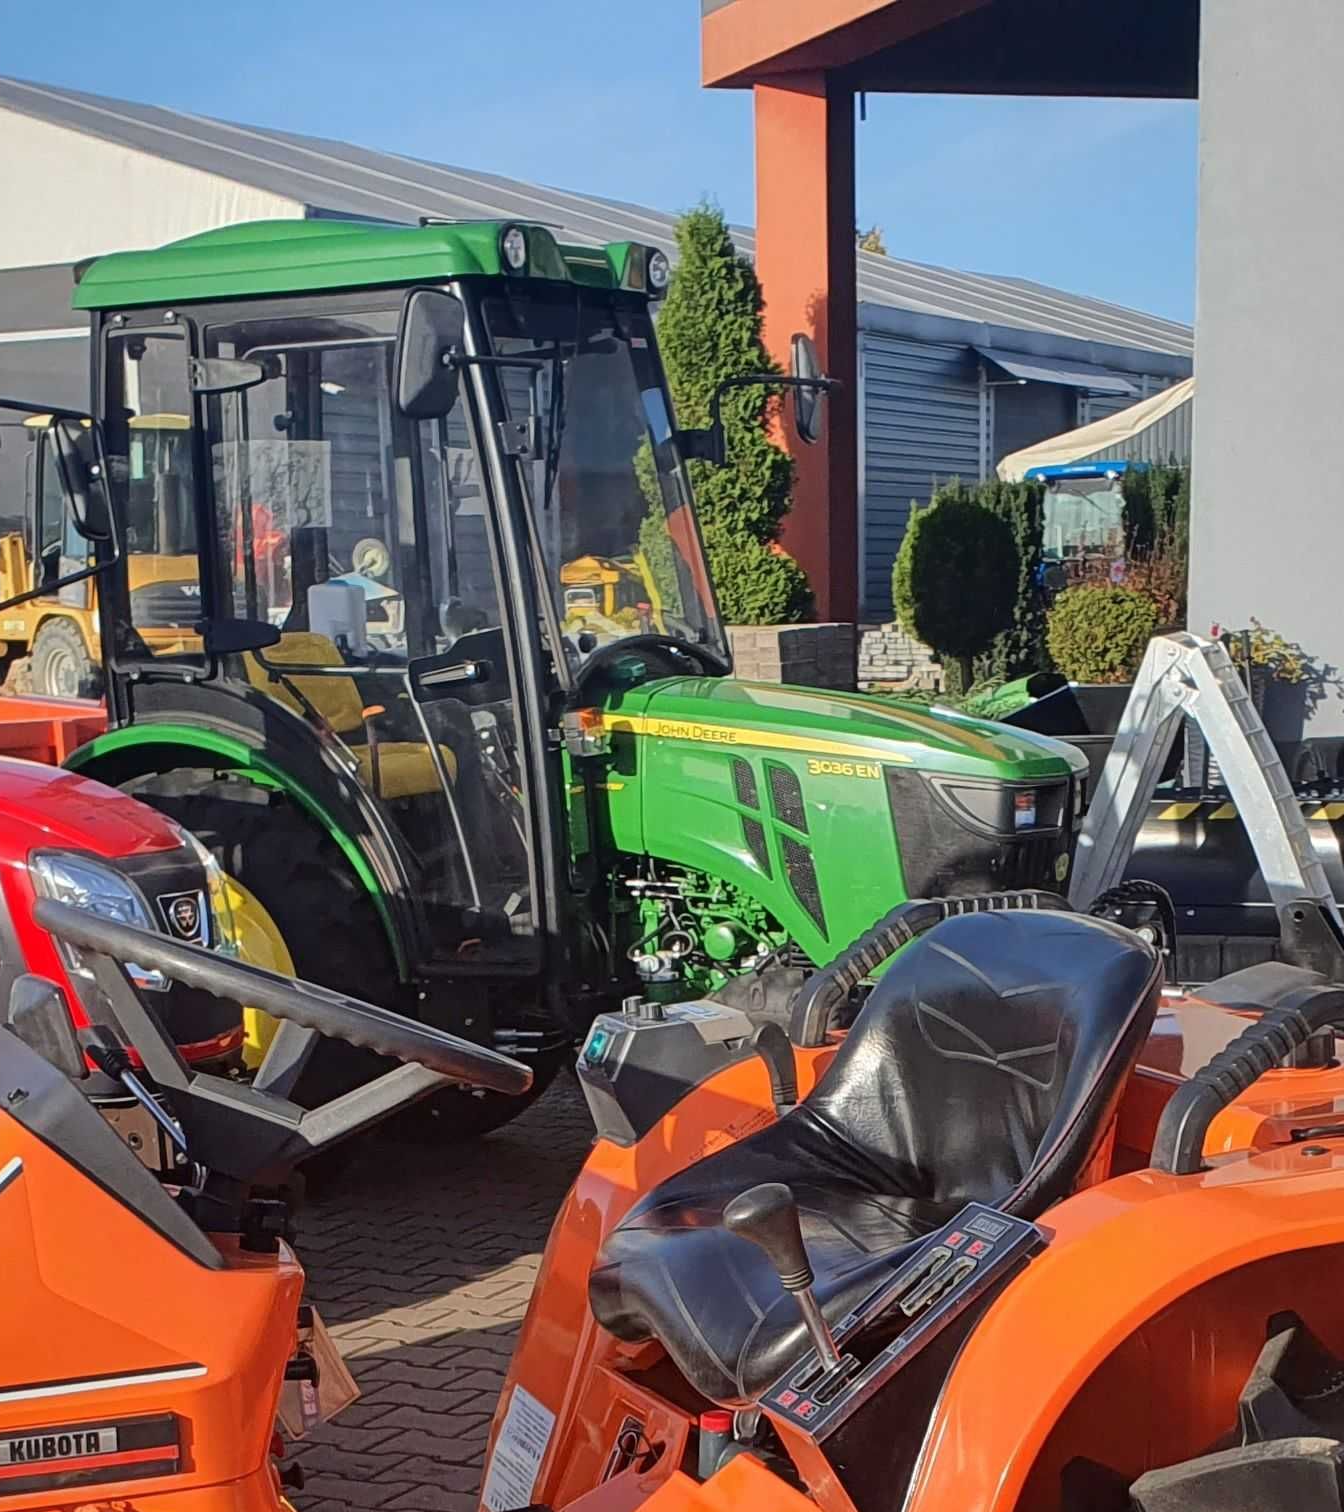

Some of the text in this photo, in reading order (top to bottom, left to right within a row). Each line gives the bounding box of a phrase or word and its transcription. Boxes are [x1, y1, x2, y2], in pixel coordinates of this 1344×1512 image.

[693, 726, 737, 743] DEERE
[808, 758, 881, 779] 3036 EN
[10, 1432, 101, 1463] KUBOTA
